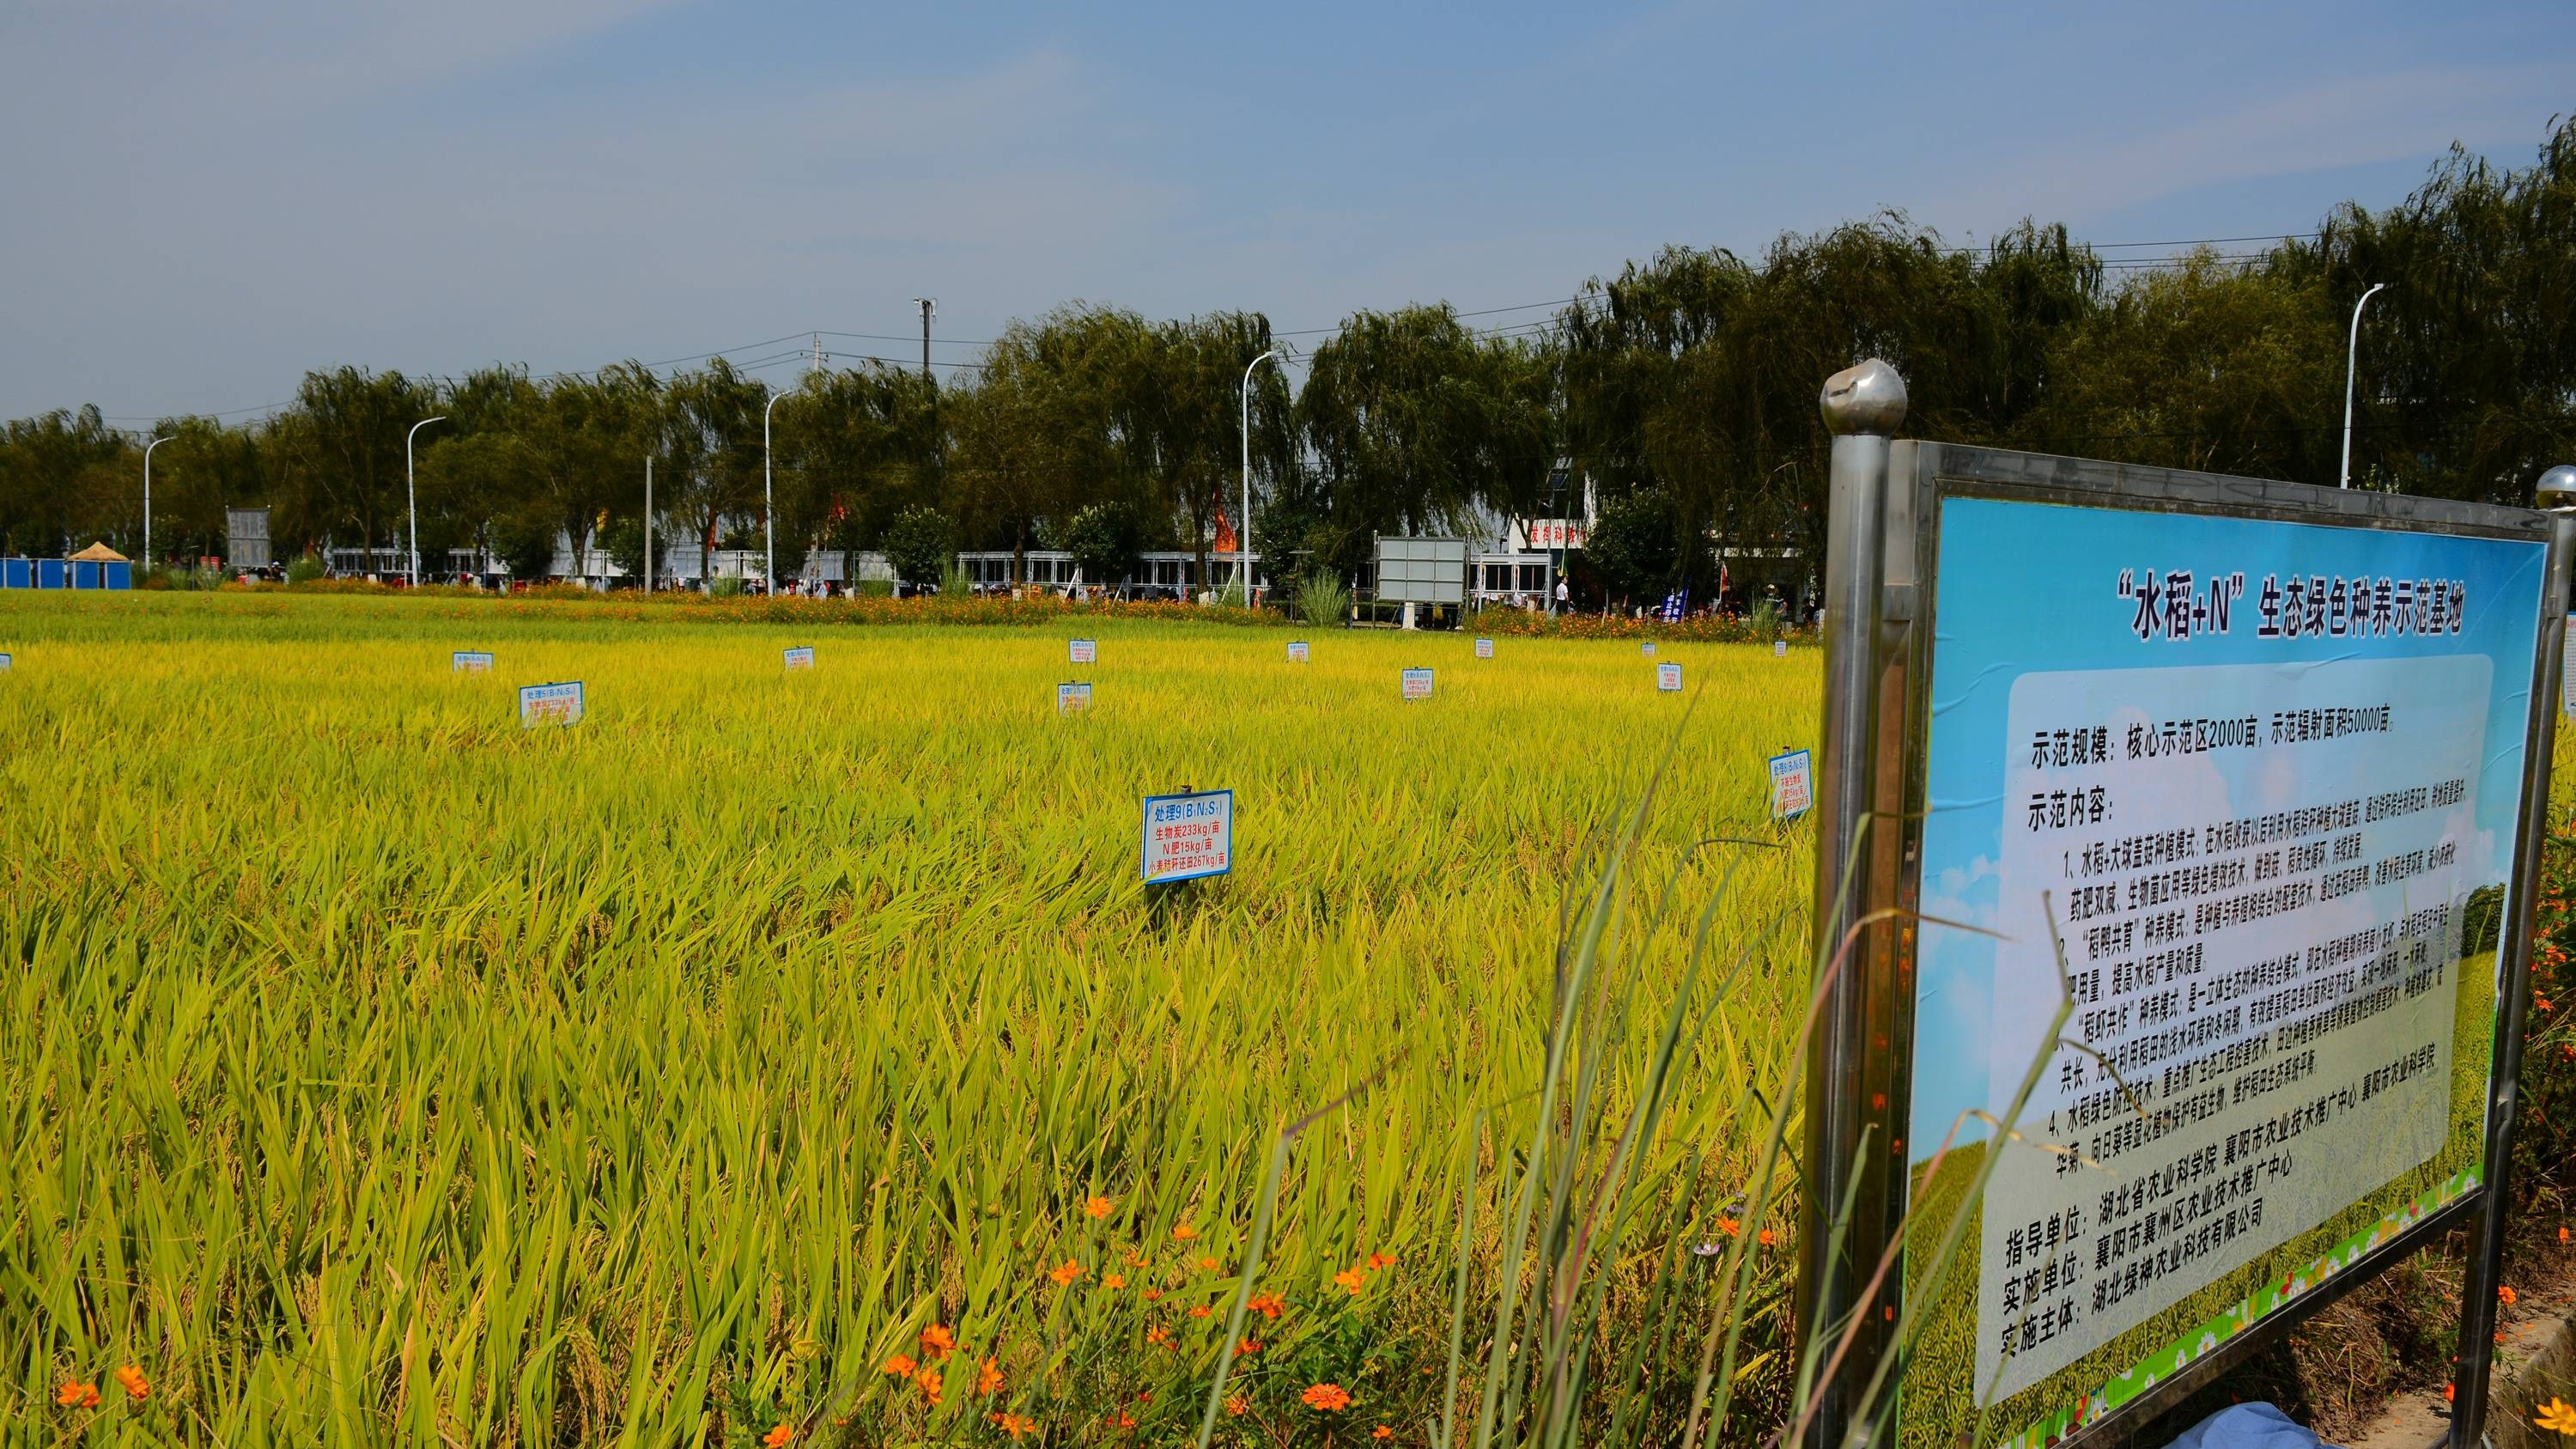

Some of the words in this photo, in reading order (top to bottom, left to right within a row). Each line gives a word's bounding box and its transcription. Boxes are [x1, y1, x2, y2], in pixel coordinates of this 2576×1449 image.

[2028, 784, 2112, 831] 示范内容：
[1156, 820, 1221, 841] 生物炭233kg/亩
[1149, 850, 1225, 874] 小麦秸秆还田267kg/亩
